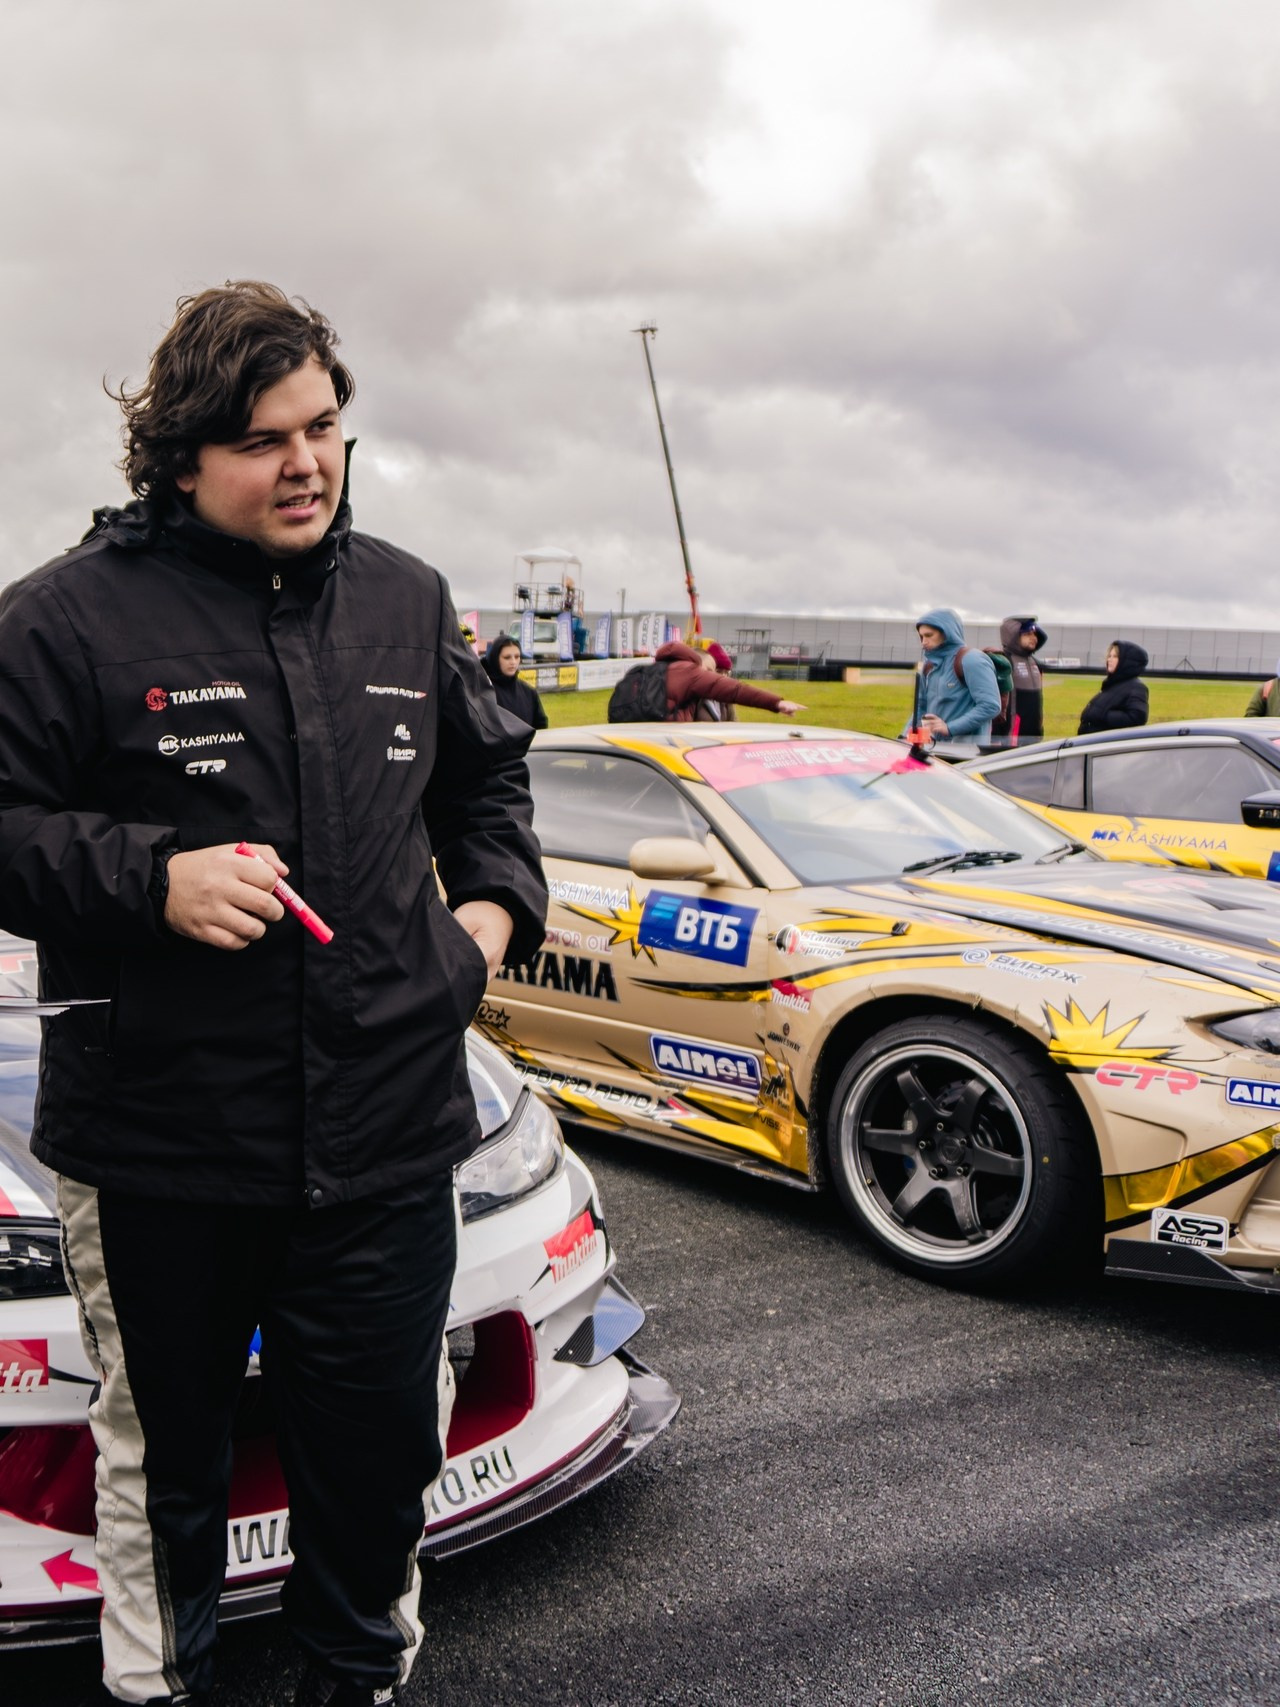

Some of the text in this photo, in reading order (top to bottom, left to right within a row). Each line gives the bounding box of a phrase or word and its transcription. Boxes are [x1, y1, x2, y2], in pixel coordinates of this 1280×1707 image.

[169, 686, 247, 705] TAKAYAMA
[181, 732, 245, 748] KASHIYAMA
[1126, 831, 1228, 851] KASHIYAMA
[548, 881, 629, 908] ASHIYAMA
[675, 906, 742, 952] ВТБ
[546, 930, 612, 953] OTOR OIL
[993, 954, 1082, 984] ВИРАЖ
[658, 1044, 758, 1085] AIMOL
[1095, 1062, 1201, 1095] CTR
[1159, 1215, 1224, 1236] ASP
[1172, 1233, 1208, 1248] Racing
